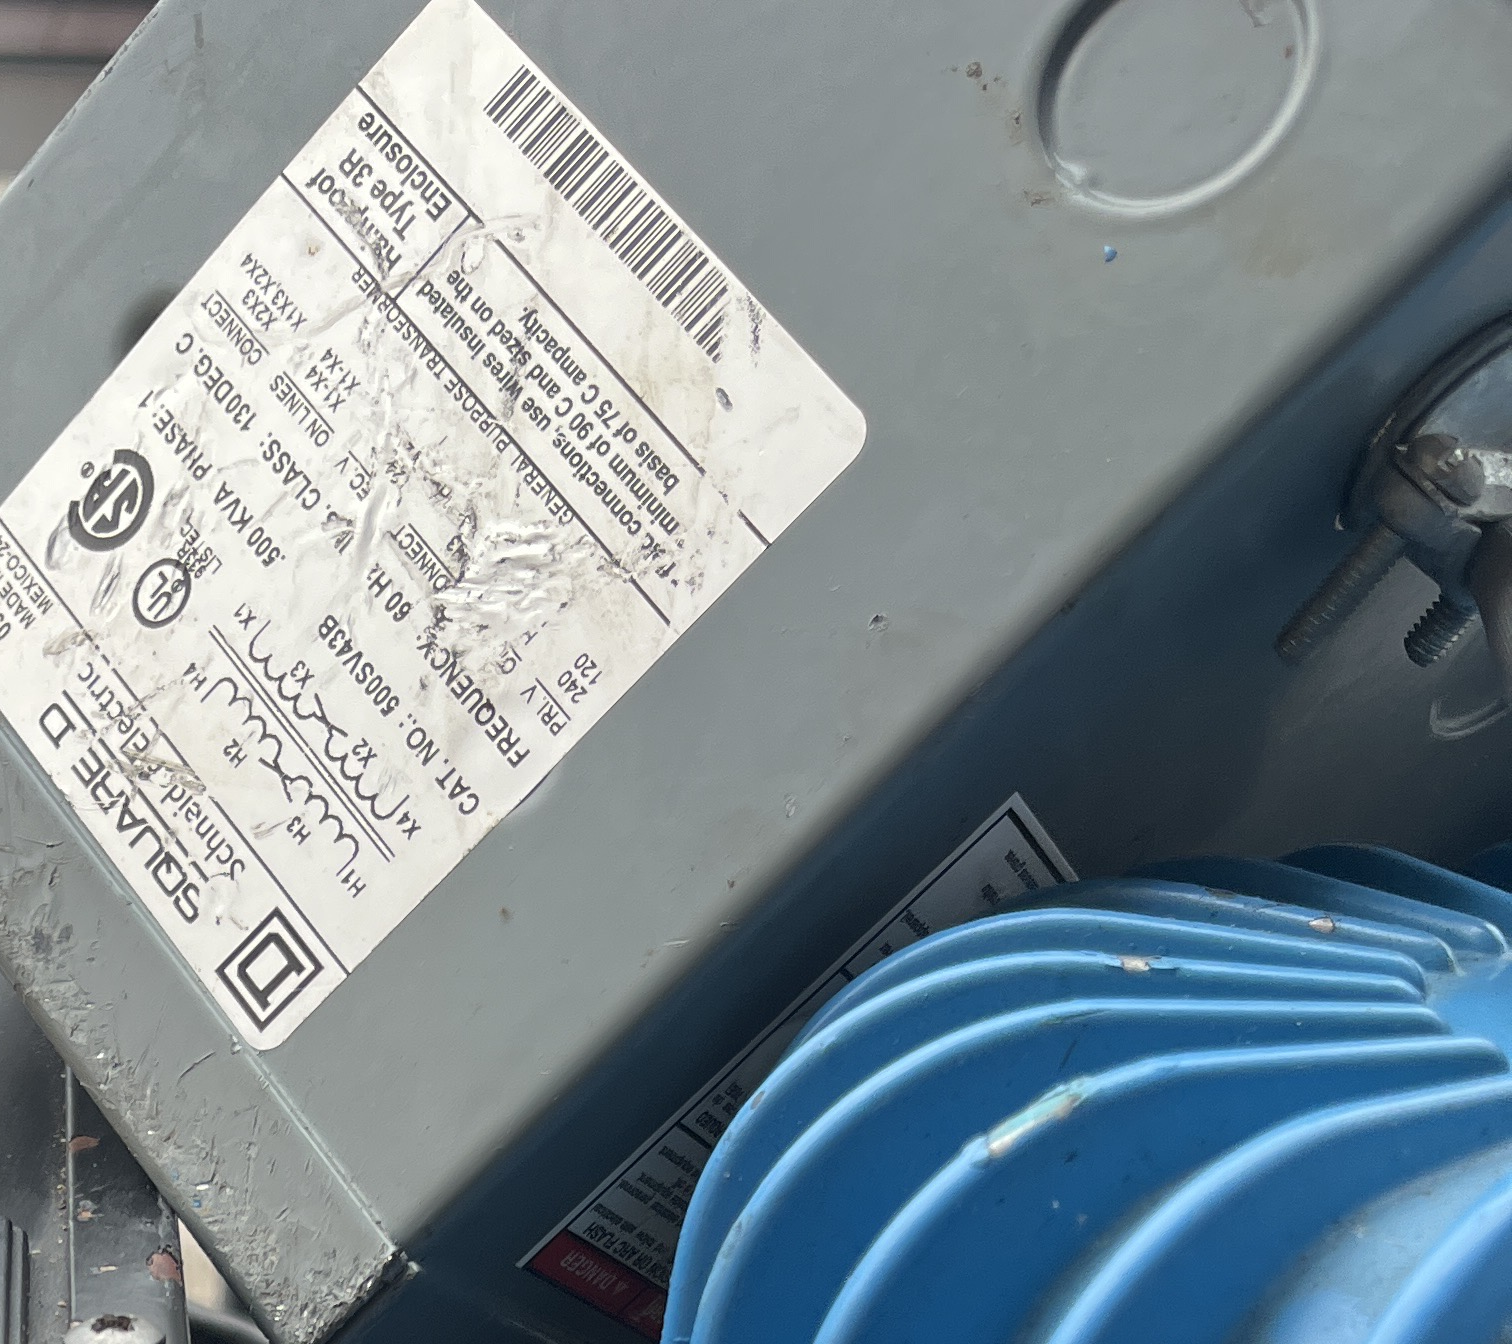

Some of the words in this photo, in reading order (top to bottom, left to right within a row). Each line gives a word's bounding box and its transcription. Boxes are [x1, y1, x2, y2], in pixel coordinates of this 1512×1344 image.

[339, 148, 373, 188] 3R
[357, 112, 453, 222] Enclosure
[370, 179, 416, 242] Type
[240, 253, 307, 332] X1X3,X2X4
[446, 270, 474, 304] the
[200, 293, 262, 366] CONNECT
[242, 289, 278, 332] X2X3
[351, 266, 447, 380] TRANSFORMER
[415, 279, 486, 361] insulated
[470, 295, 494, 323] on
[175, 332, 194, 355] C
[486, 319, 532, 371] sized
[518, 306, 588, 386] ampacity.
[304, 365, 346, 413] X1-X4
[320, 347, 361, 391] X1-X4
[482, 352, 524, 403] wires
[524, 363, 561, 399] and
[138, 390, 154, 408] 1
[269, 375, 311, 425] LINES
[521, 397, 552, 431] use
[554, 397, 574, 418] C
[580, 384, 600, 405] C
[593, 399, 621, 430] 75
[305, 418, 330, 447] ON
[443, 379, 512, 454] PURPOSE
[568, 412, 594, 441] 90
[612, 420, 638, 444] of
[152, 409, 213, 481] PHASE:
[334, 456, 349, 474] V
[585, 434, 611, 457] of
[259, 432, 321, 511] CLASS:
[349, 472, 370, 502] EC.
[552, 426, 642, 537] connections,
[634, 441, 680, 496] basis
[214, 480, 254, 534] KVA
[510, 452, 575, 527] GENERAL
[608, 453, 680, 536] minimum
[246, 526, 286, 567] .500
[386, 525, 452, 594] ONNECT
[234, 602, 257, 631] X1
[384, 591, 413, 623] 60
[182, 662, 207, 692] H4
[290, 660, 315, 690] X3
[318, 614, 400, 717] 500SV43B
[573, 653, 603, 685] 120
[416, 630, 531, 770] FREQUENCY:
[519, 684, 538, 705] V
[557, 670, 588, 704] 240
[39, 702, 77, 750] D
[77, 661, 151, 766] Electric
[536, 700, 568, 736] PRI.
[223, 738, 248, 769] H2
[351, 737, 378, 770] X2
[398, 713, 441, 767] NO.:
[434, 758, 480, 815] CAT.
[70, 746, 200, 924] SQUARE
[286, 815, 312, 846] H3
[396, 810, 422, 841] X4
[340, 868, 367, 899] H1
[583, 1222, 620, 1249] FLASH
[560, 1250, 617, 1294] DANGER
